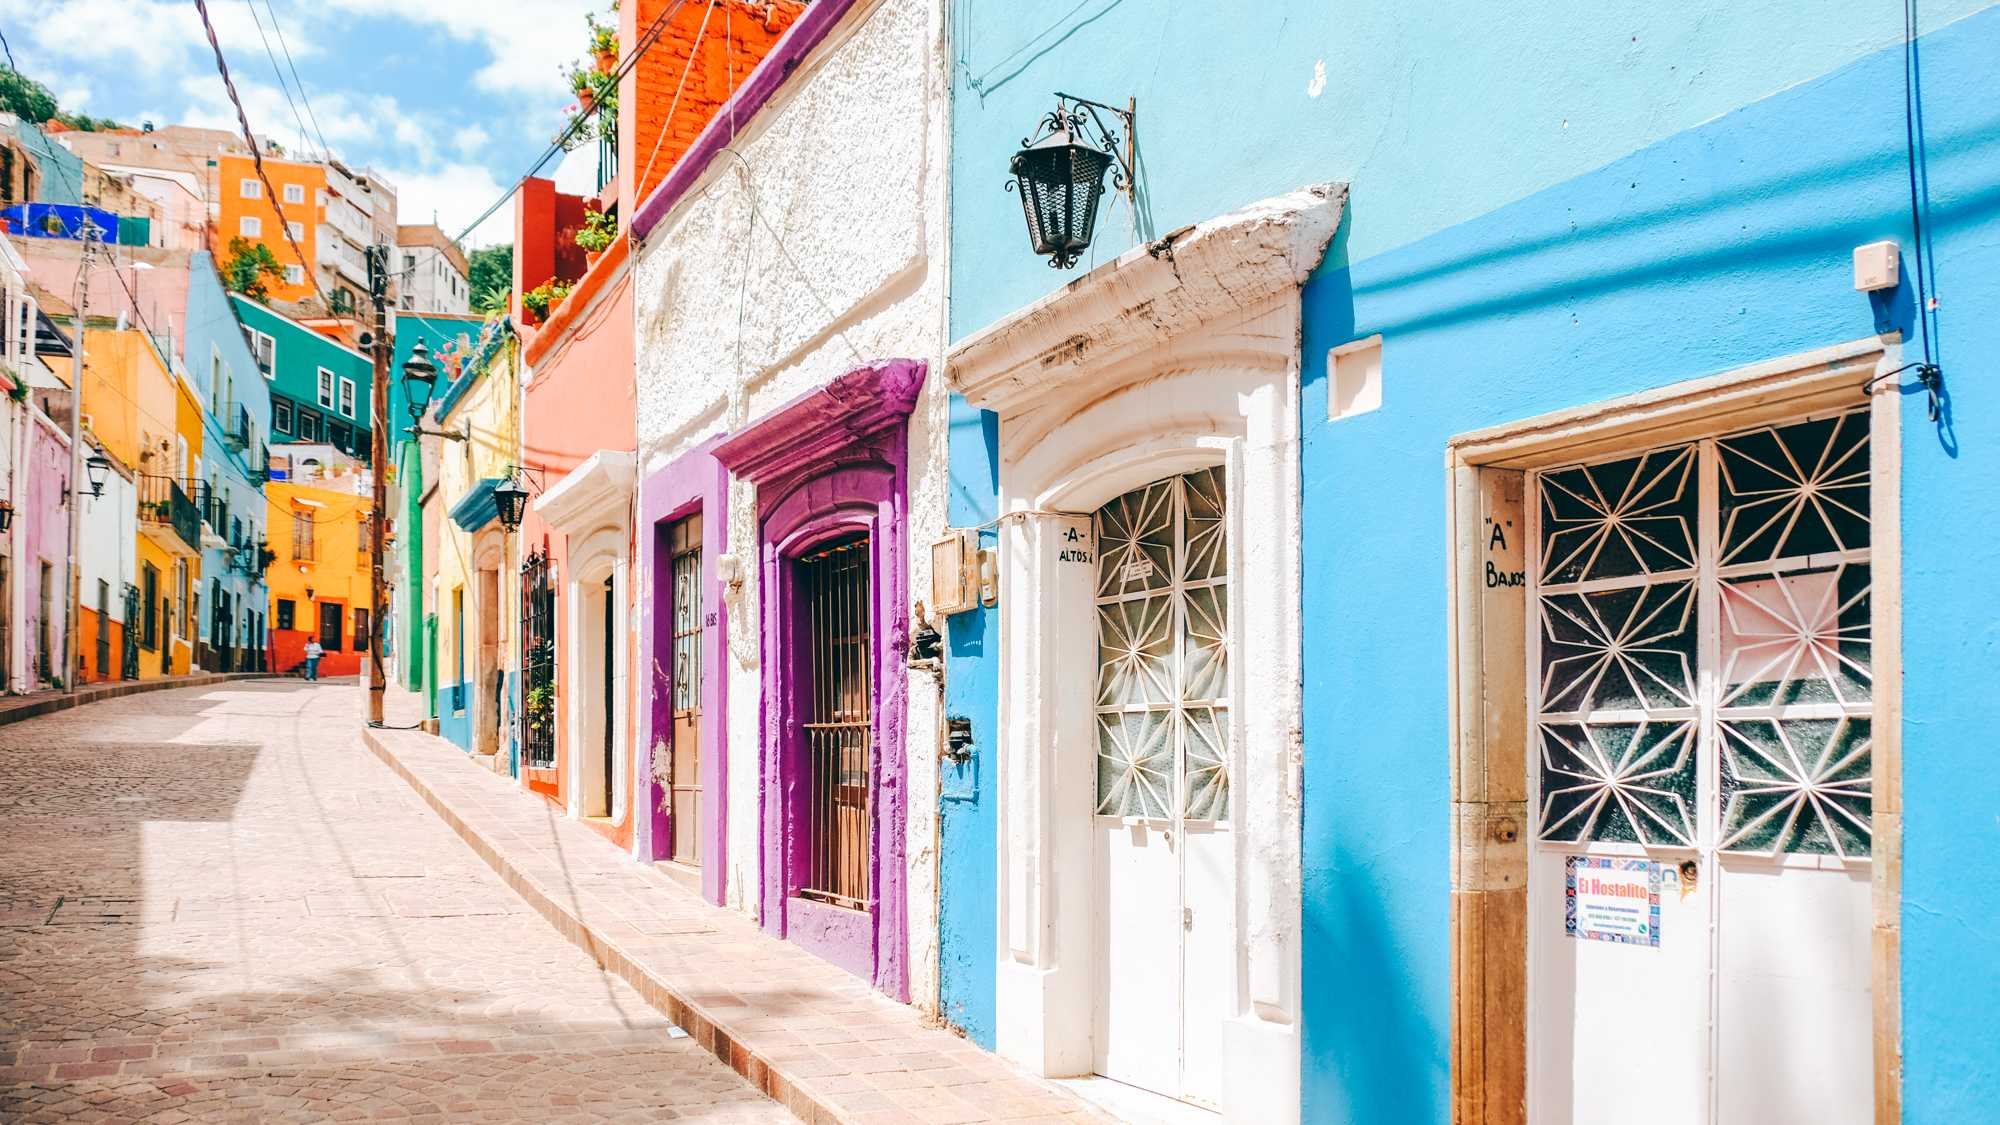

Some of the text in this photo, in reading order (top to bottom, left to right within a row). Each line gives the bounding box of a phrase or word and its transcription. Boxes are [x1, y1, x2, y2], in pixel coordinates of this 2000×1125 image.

[1059, 550, 1087, 562] ALTOS
[1578, 878, 1647, 899] El Hostalito
